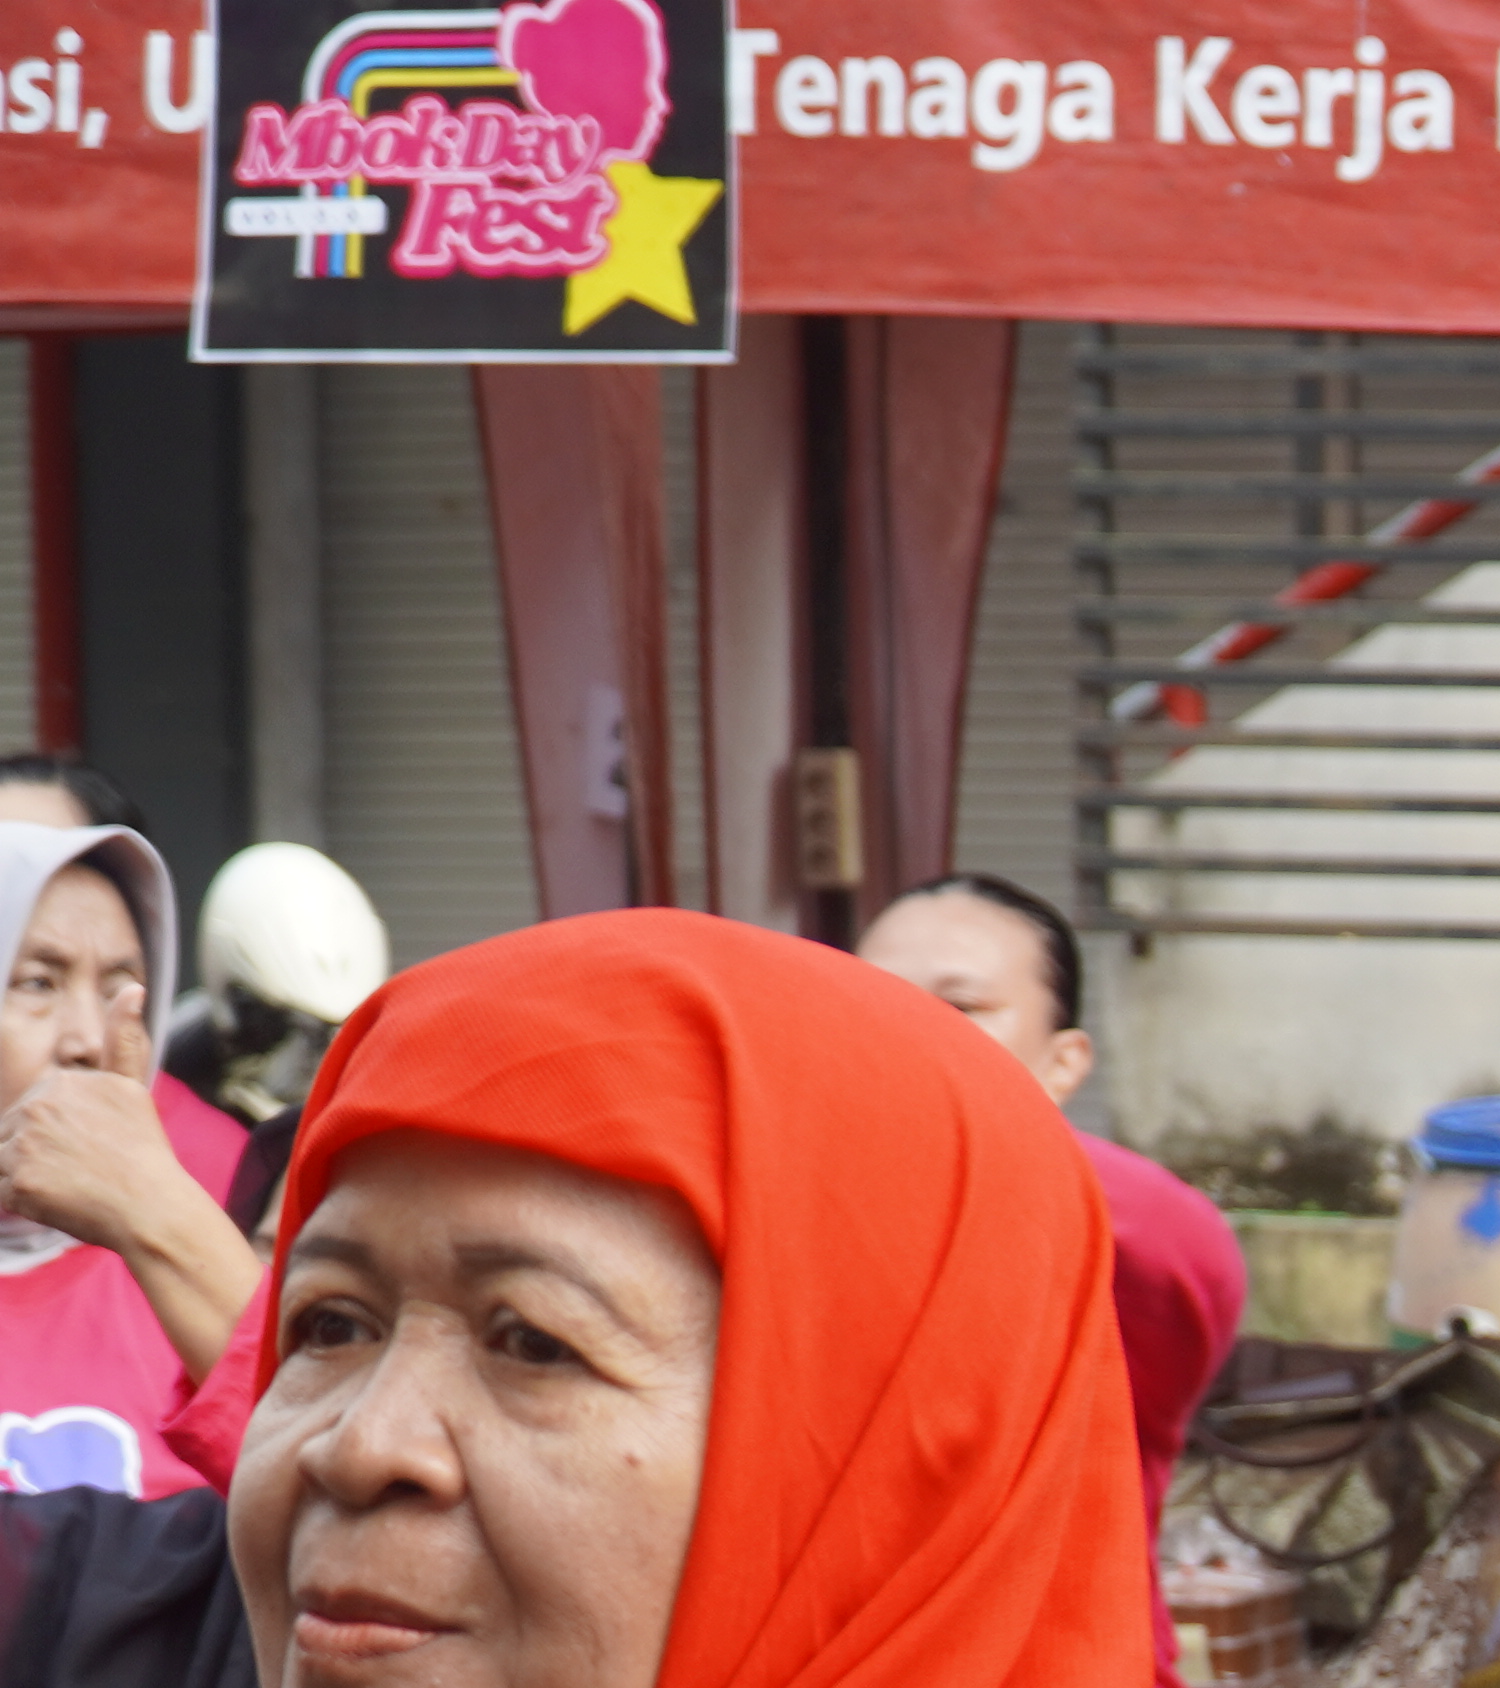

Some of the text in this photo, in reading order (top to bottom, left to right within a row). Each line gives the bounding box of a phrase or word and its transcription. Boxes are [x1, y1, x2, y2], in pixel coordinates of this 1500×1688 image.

[0, 26, 109, 149] si,
[729, 28, 1115, 171] Tenaga
[1156, 36, 1455, 182] Kerja
[396, 170, 616, 268] Fest
